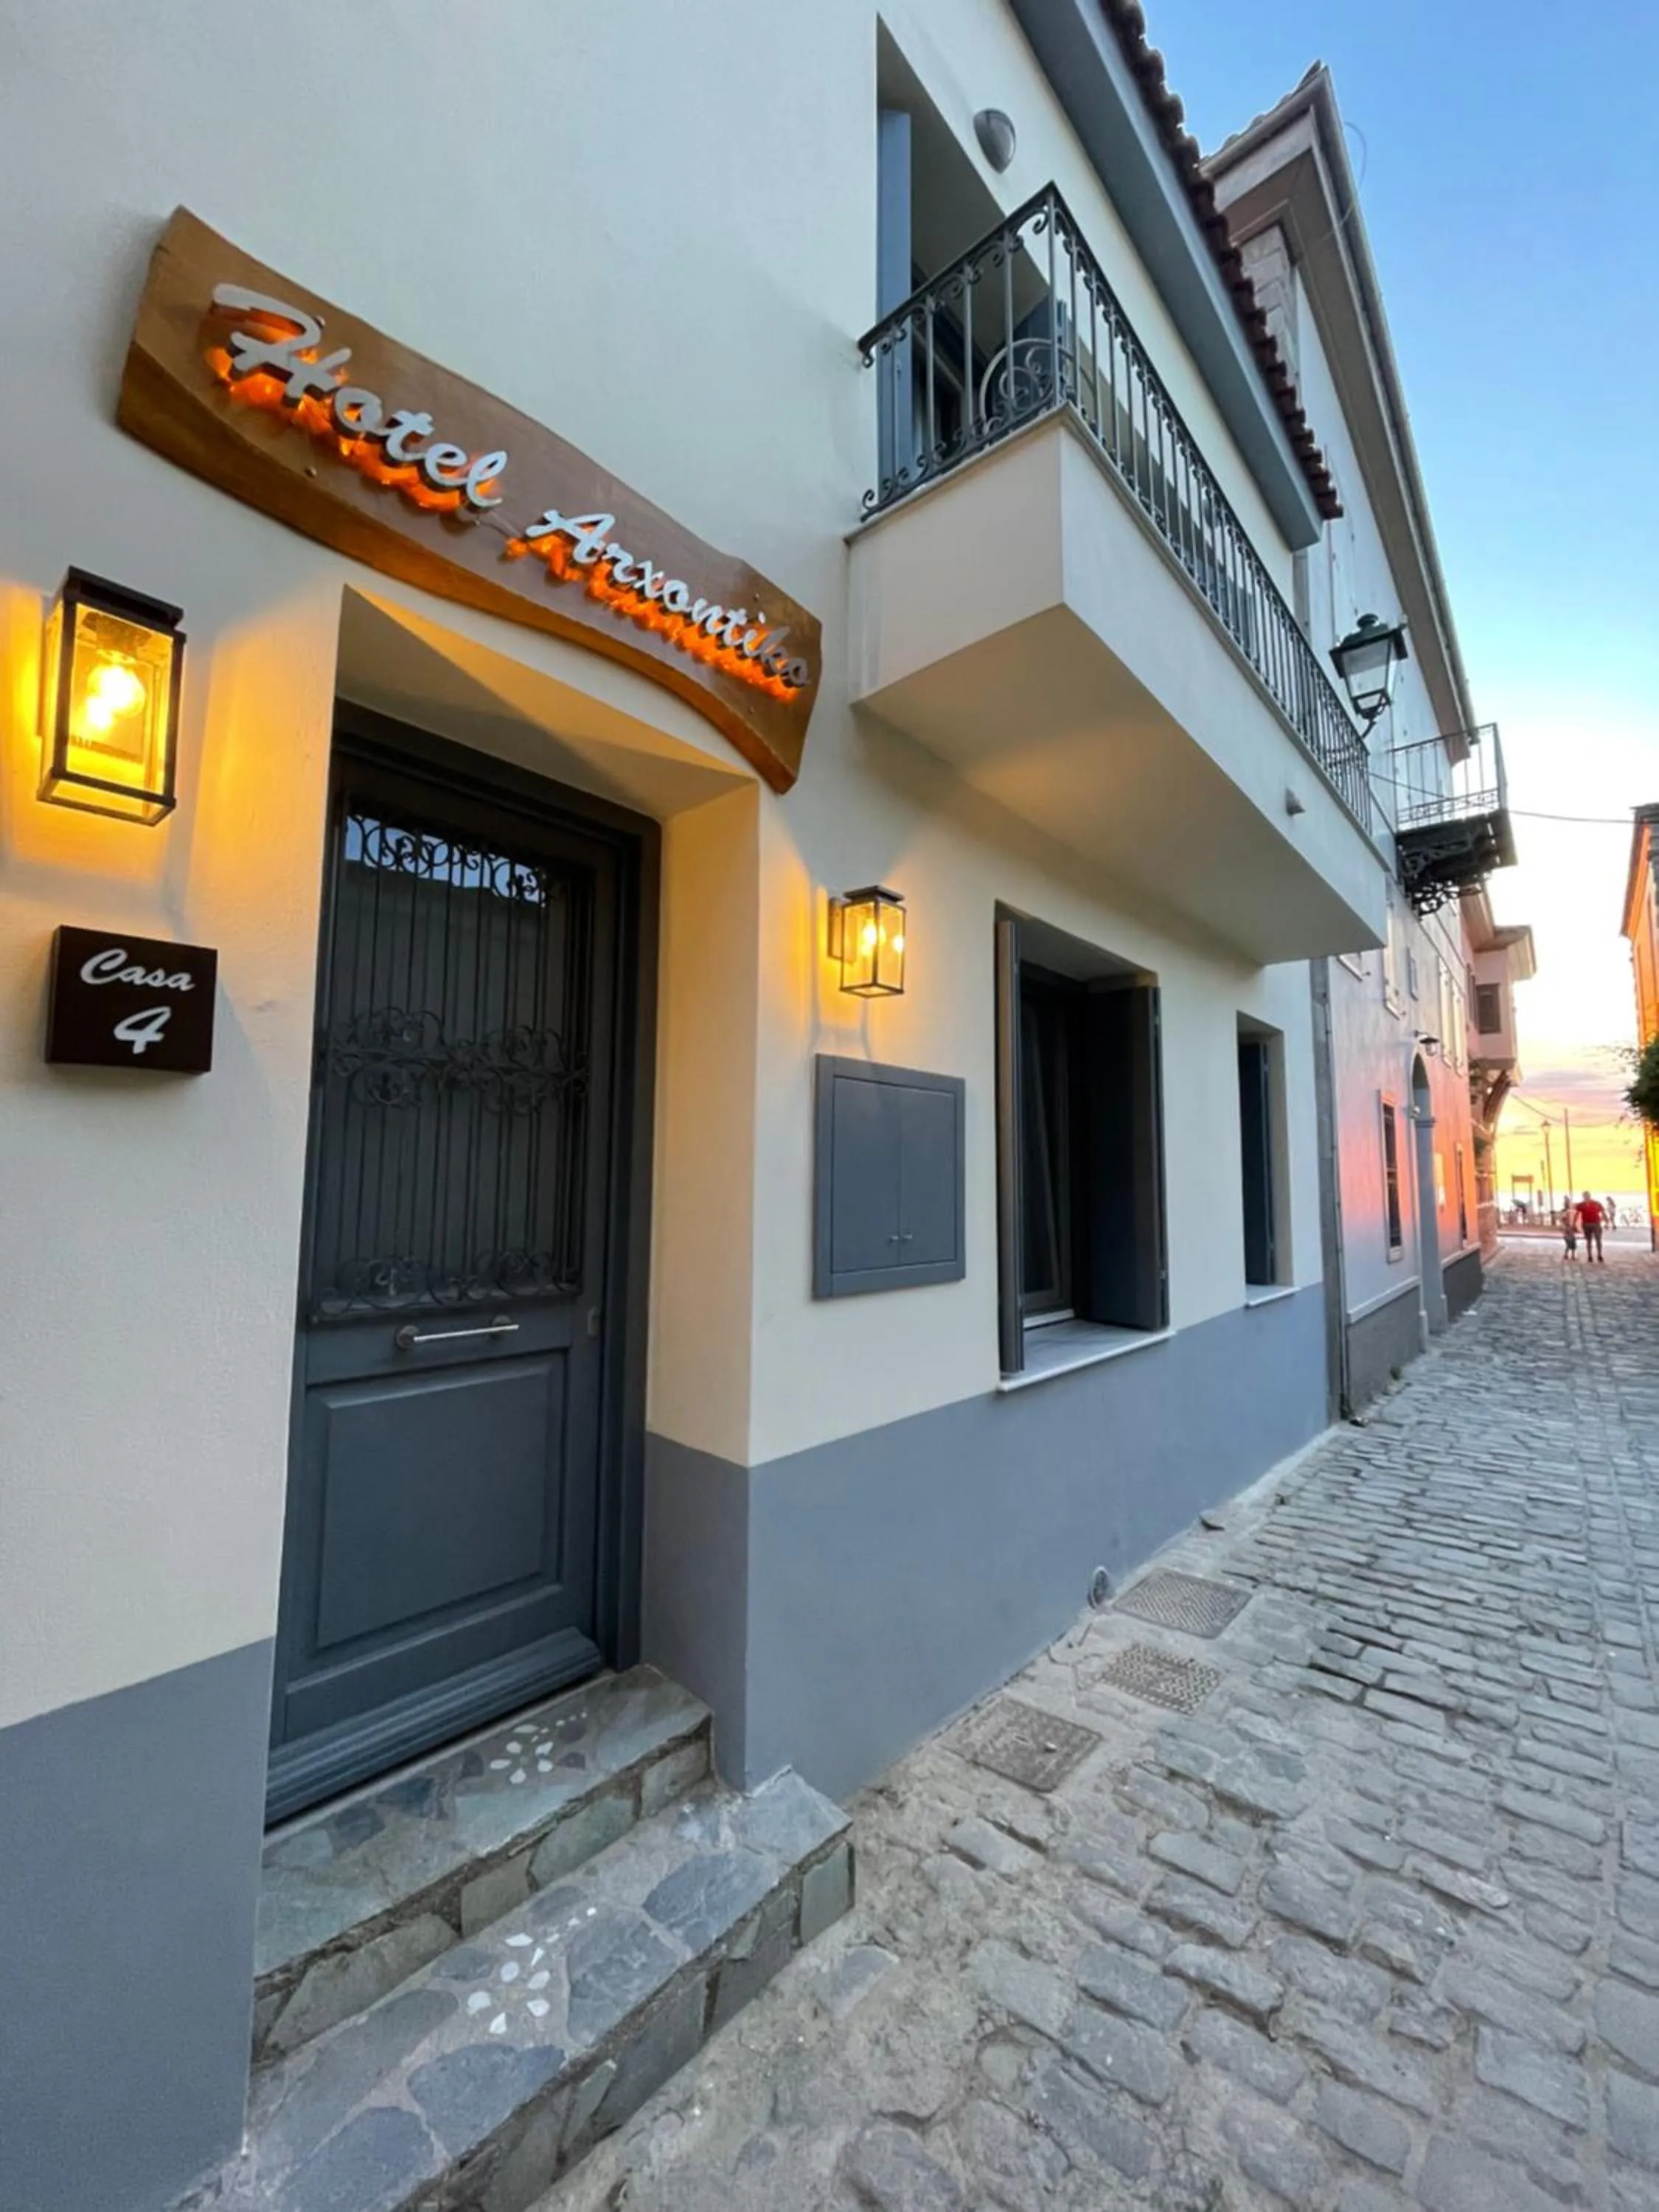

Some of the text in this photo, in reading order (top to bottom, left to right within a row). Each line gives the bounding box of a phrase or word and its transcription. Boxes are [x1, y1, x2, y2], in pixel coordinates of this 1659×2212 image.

[212, 282, 812, 689] Hotel Arxontiko
[80, 947, 196, 992] Casa
[113, 1005, 173, 1055] 4
